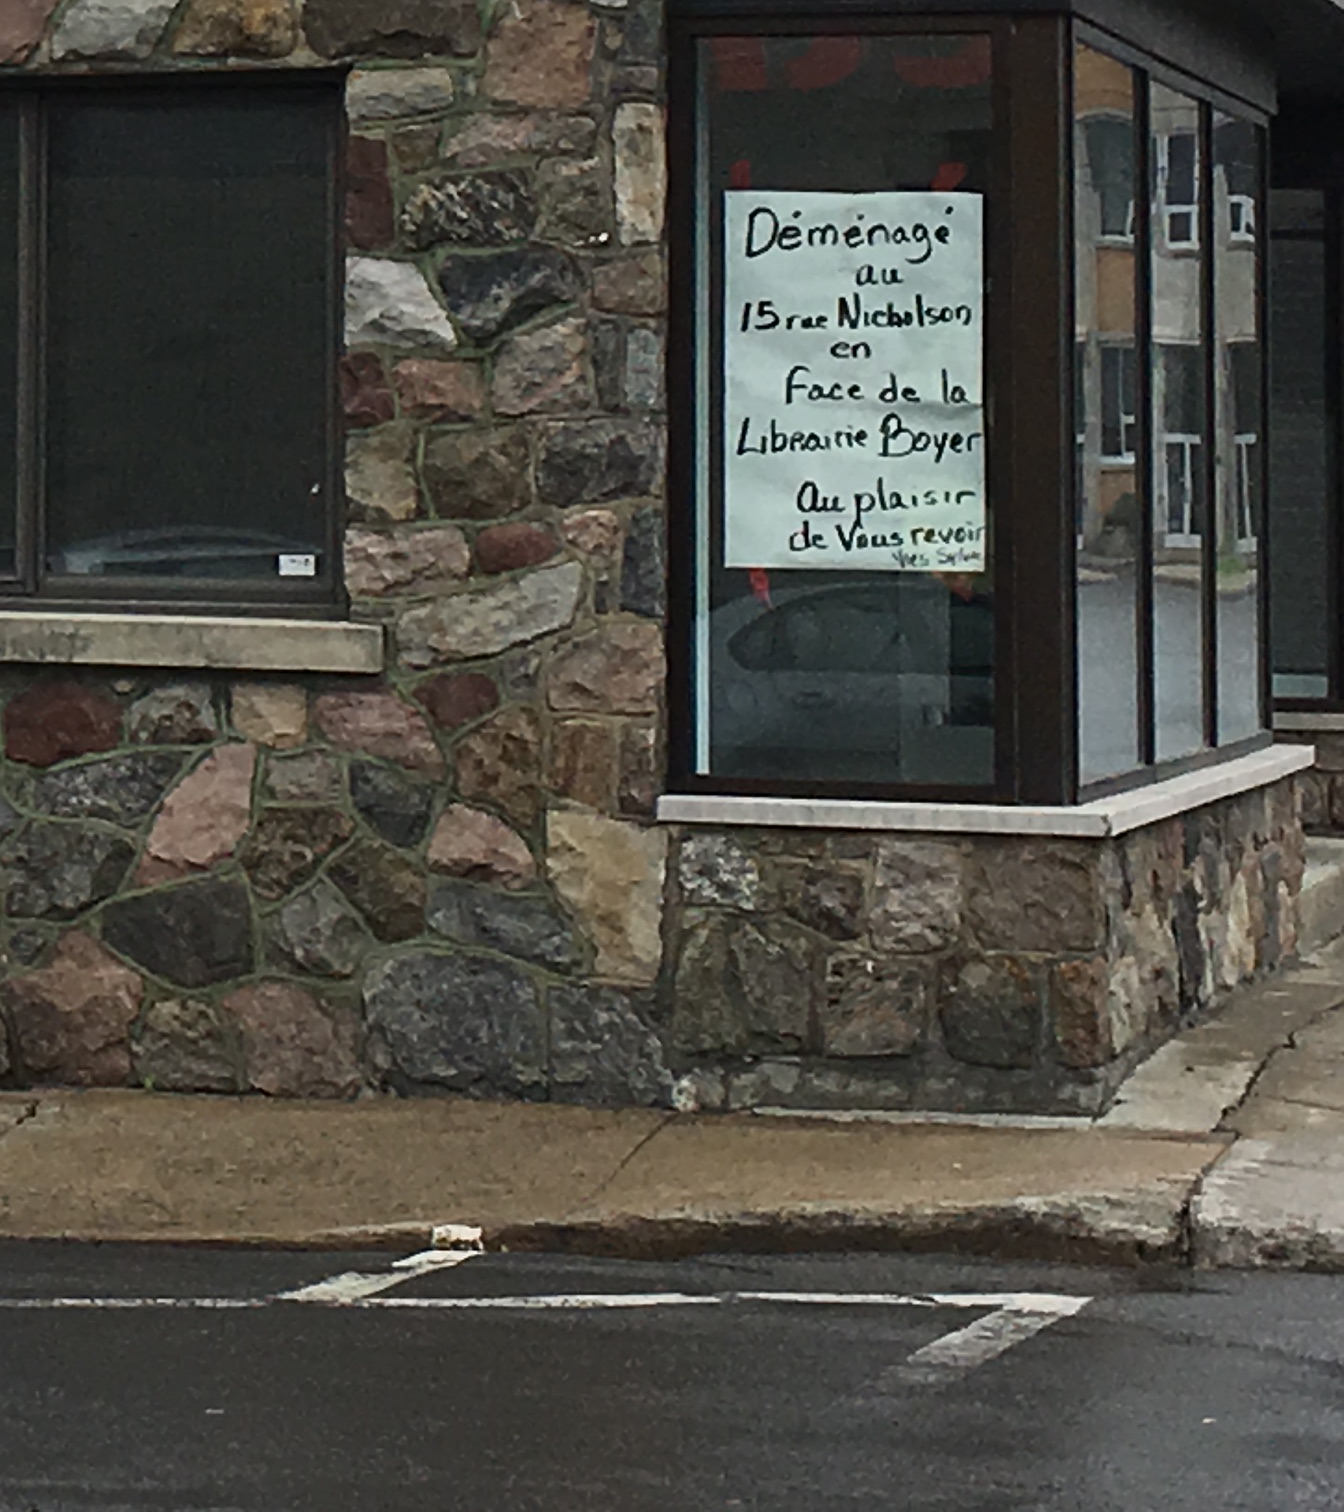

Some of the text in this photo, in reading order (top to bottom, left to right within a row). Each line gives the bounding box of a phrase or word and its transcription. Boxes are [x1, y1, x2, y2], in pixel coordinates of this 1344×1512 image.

[745, 206, 954, 264] Déménagé
[855, 264, 904, 286] au
[740, 292, 972, 332] 15 rue Nicholson
[830, 341, 872, 358] en
[879, 372, 921, 403] de
[942, 368, 970, 403] la
[878, 412, 983, 464] Boyer
[854, 476, 976, 528] plaisir
[789, 520, 828, 552] de
[910, 521, 985, 546] revoir
